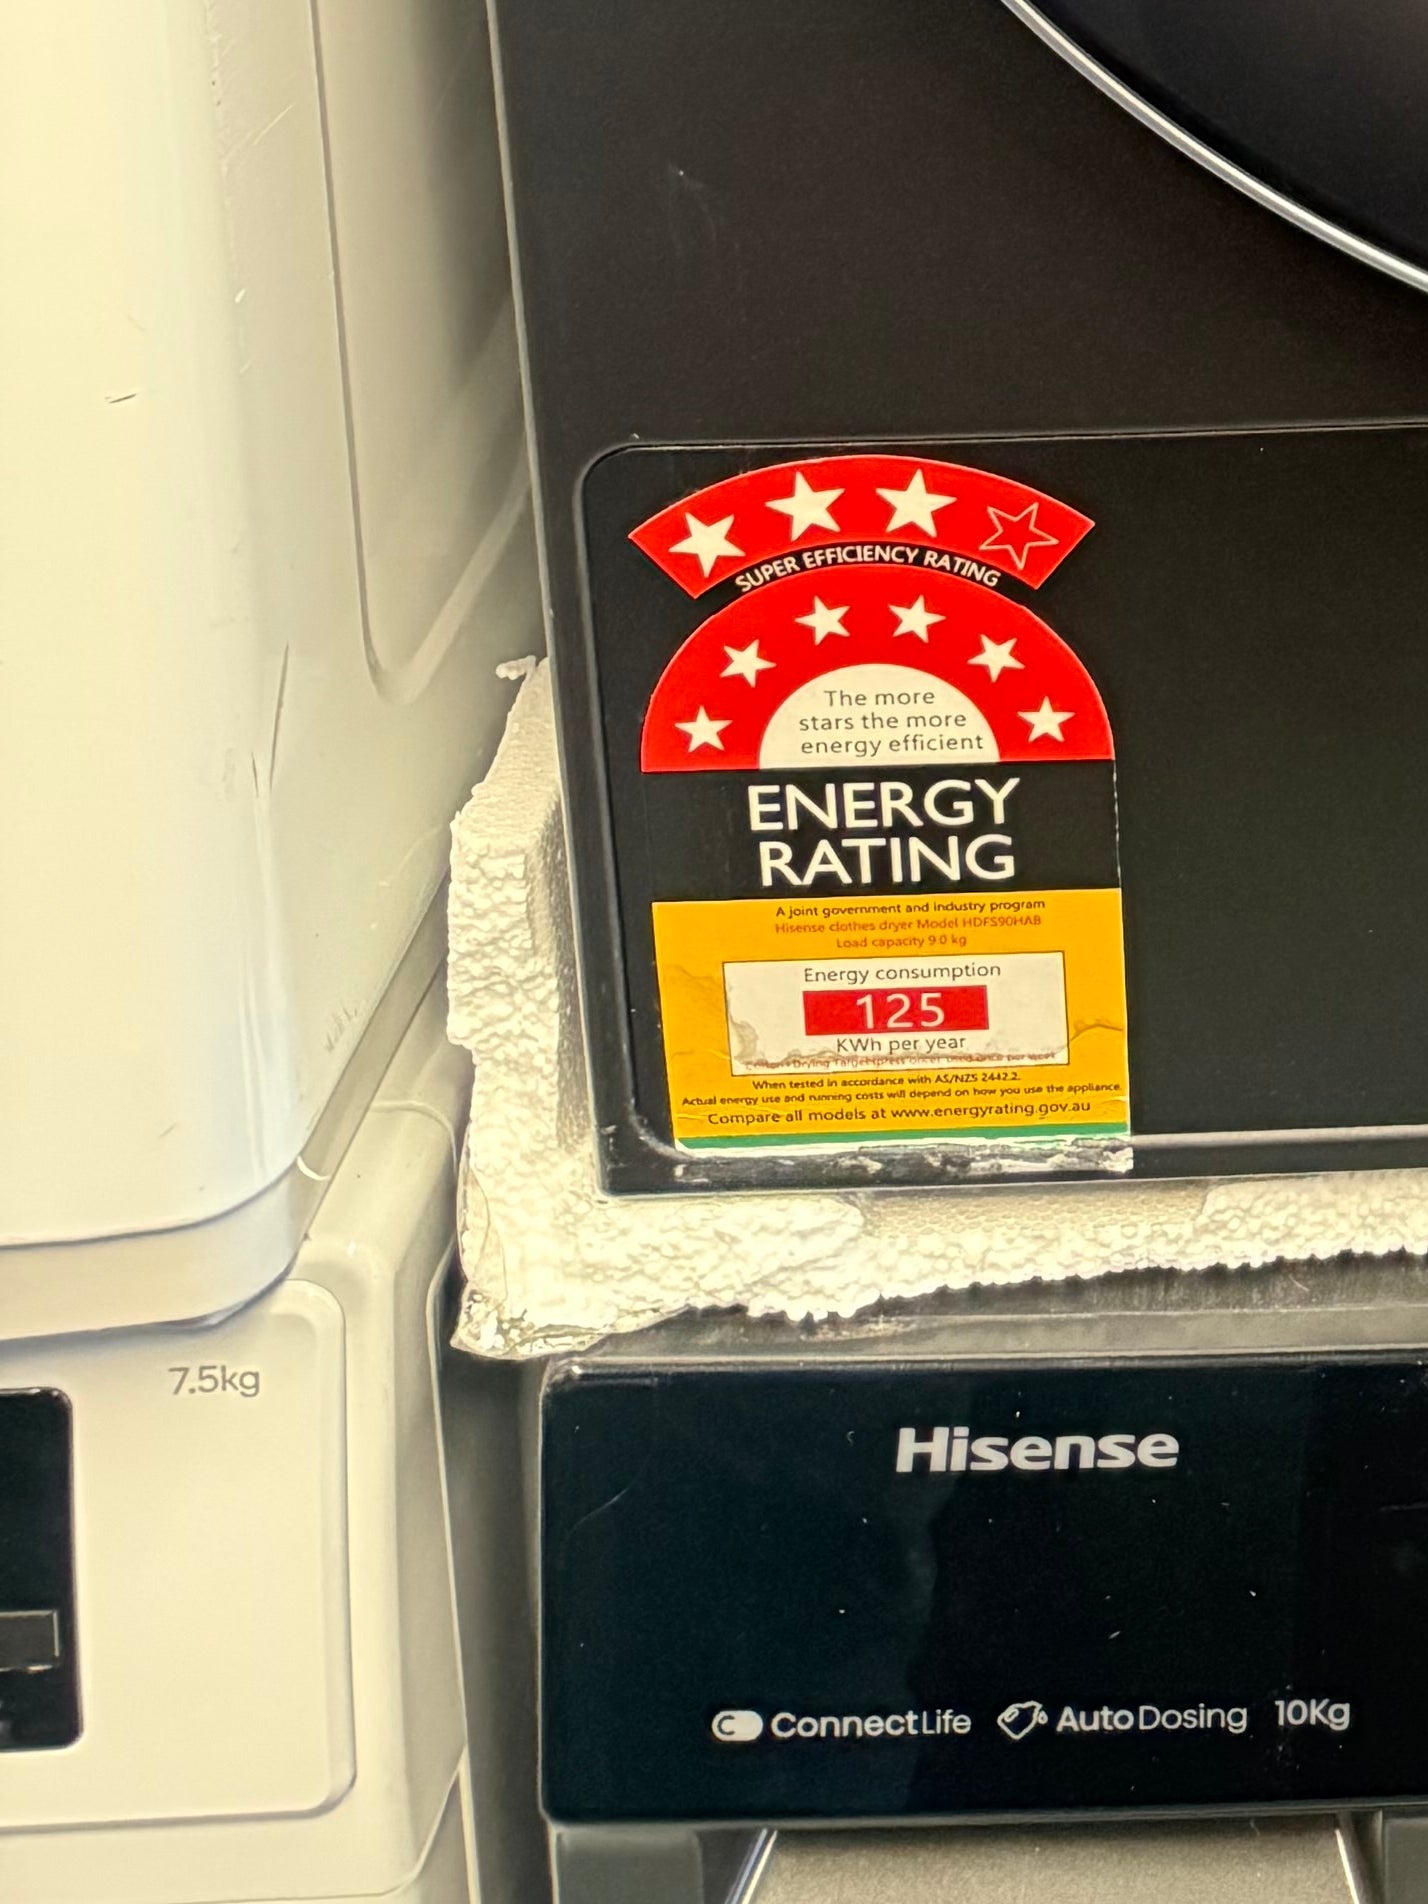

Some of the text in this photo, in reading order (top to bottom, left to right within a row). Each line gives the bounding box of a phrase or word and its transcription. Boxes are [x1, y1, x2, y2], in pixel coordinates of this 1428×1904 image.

[734, 546, 1001, 593] SUPER EFFICIENCY RATING
[824, 690, 935, 708] The more
[799, 712, 966, 731] stars the more
[801, 733, 984, 758] energy efficient
[747, 777, 1020, 832] ENERGY
[759, 835, 1015, 887] RATING
[776, 899, 1045, 919] A joint government and industry program
[804, 964, 1001, 985] Energy consumption
[855, 993, 945, 1030] 125
[836, 1036, 967, 1056] KWh per year
[707, 1100, 1091, 1127] Compare all models at www.energyrating.gov.au
[168, 1365, 261, 1398] 7.5kg
[896, 1427, 1179, 1472] Hisense
[772, 1698, 1351, 1739] ConnectLife AutoDosing 10Kg
